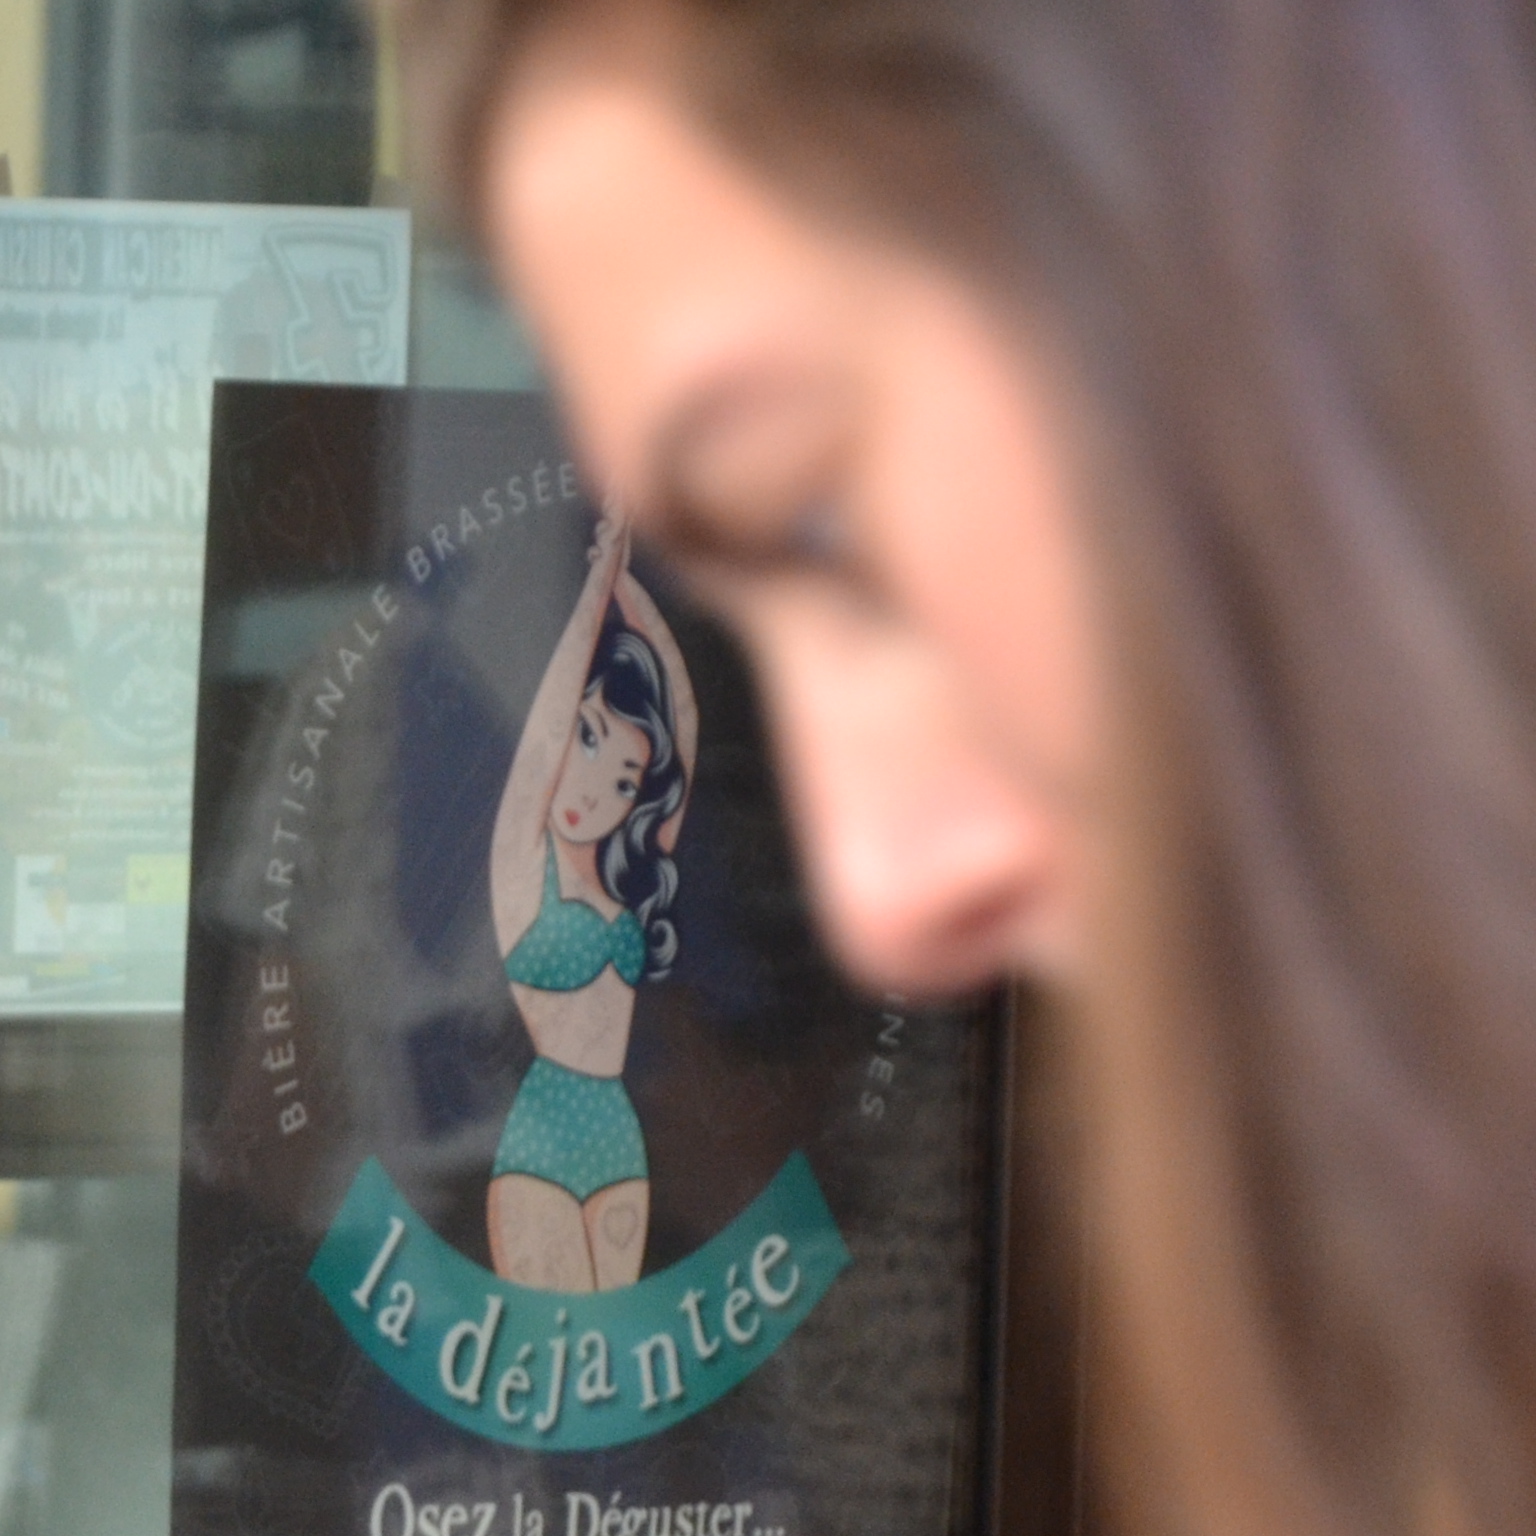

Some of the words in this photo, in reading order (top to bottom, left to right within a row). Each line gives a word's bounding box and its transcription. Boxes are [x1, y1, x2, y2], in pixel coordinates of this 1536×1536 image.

[406, 459, 577, 583] BRASSÉE
[264, 584, 400, 931] ARTISANALE
[260, 962, 308, 1136] BIÈRE
[351, 1218, 417, 1347] la
[438, 1233, 800, 1432] déjantée
